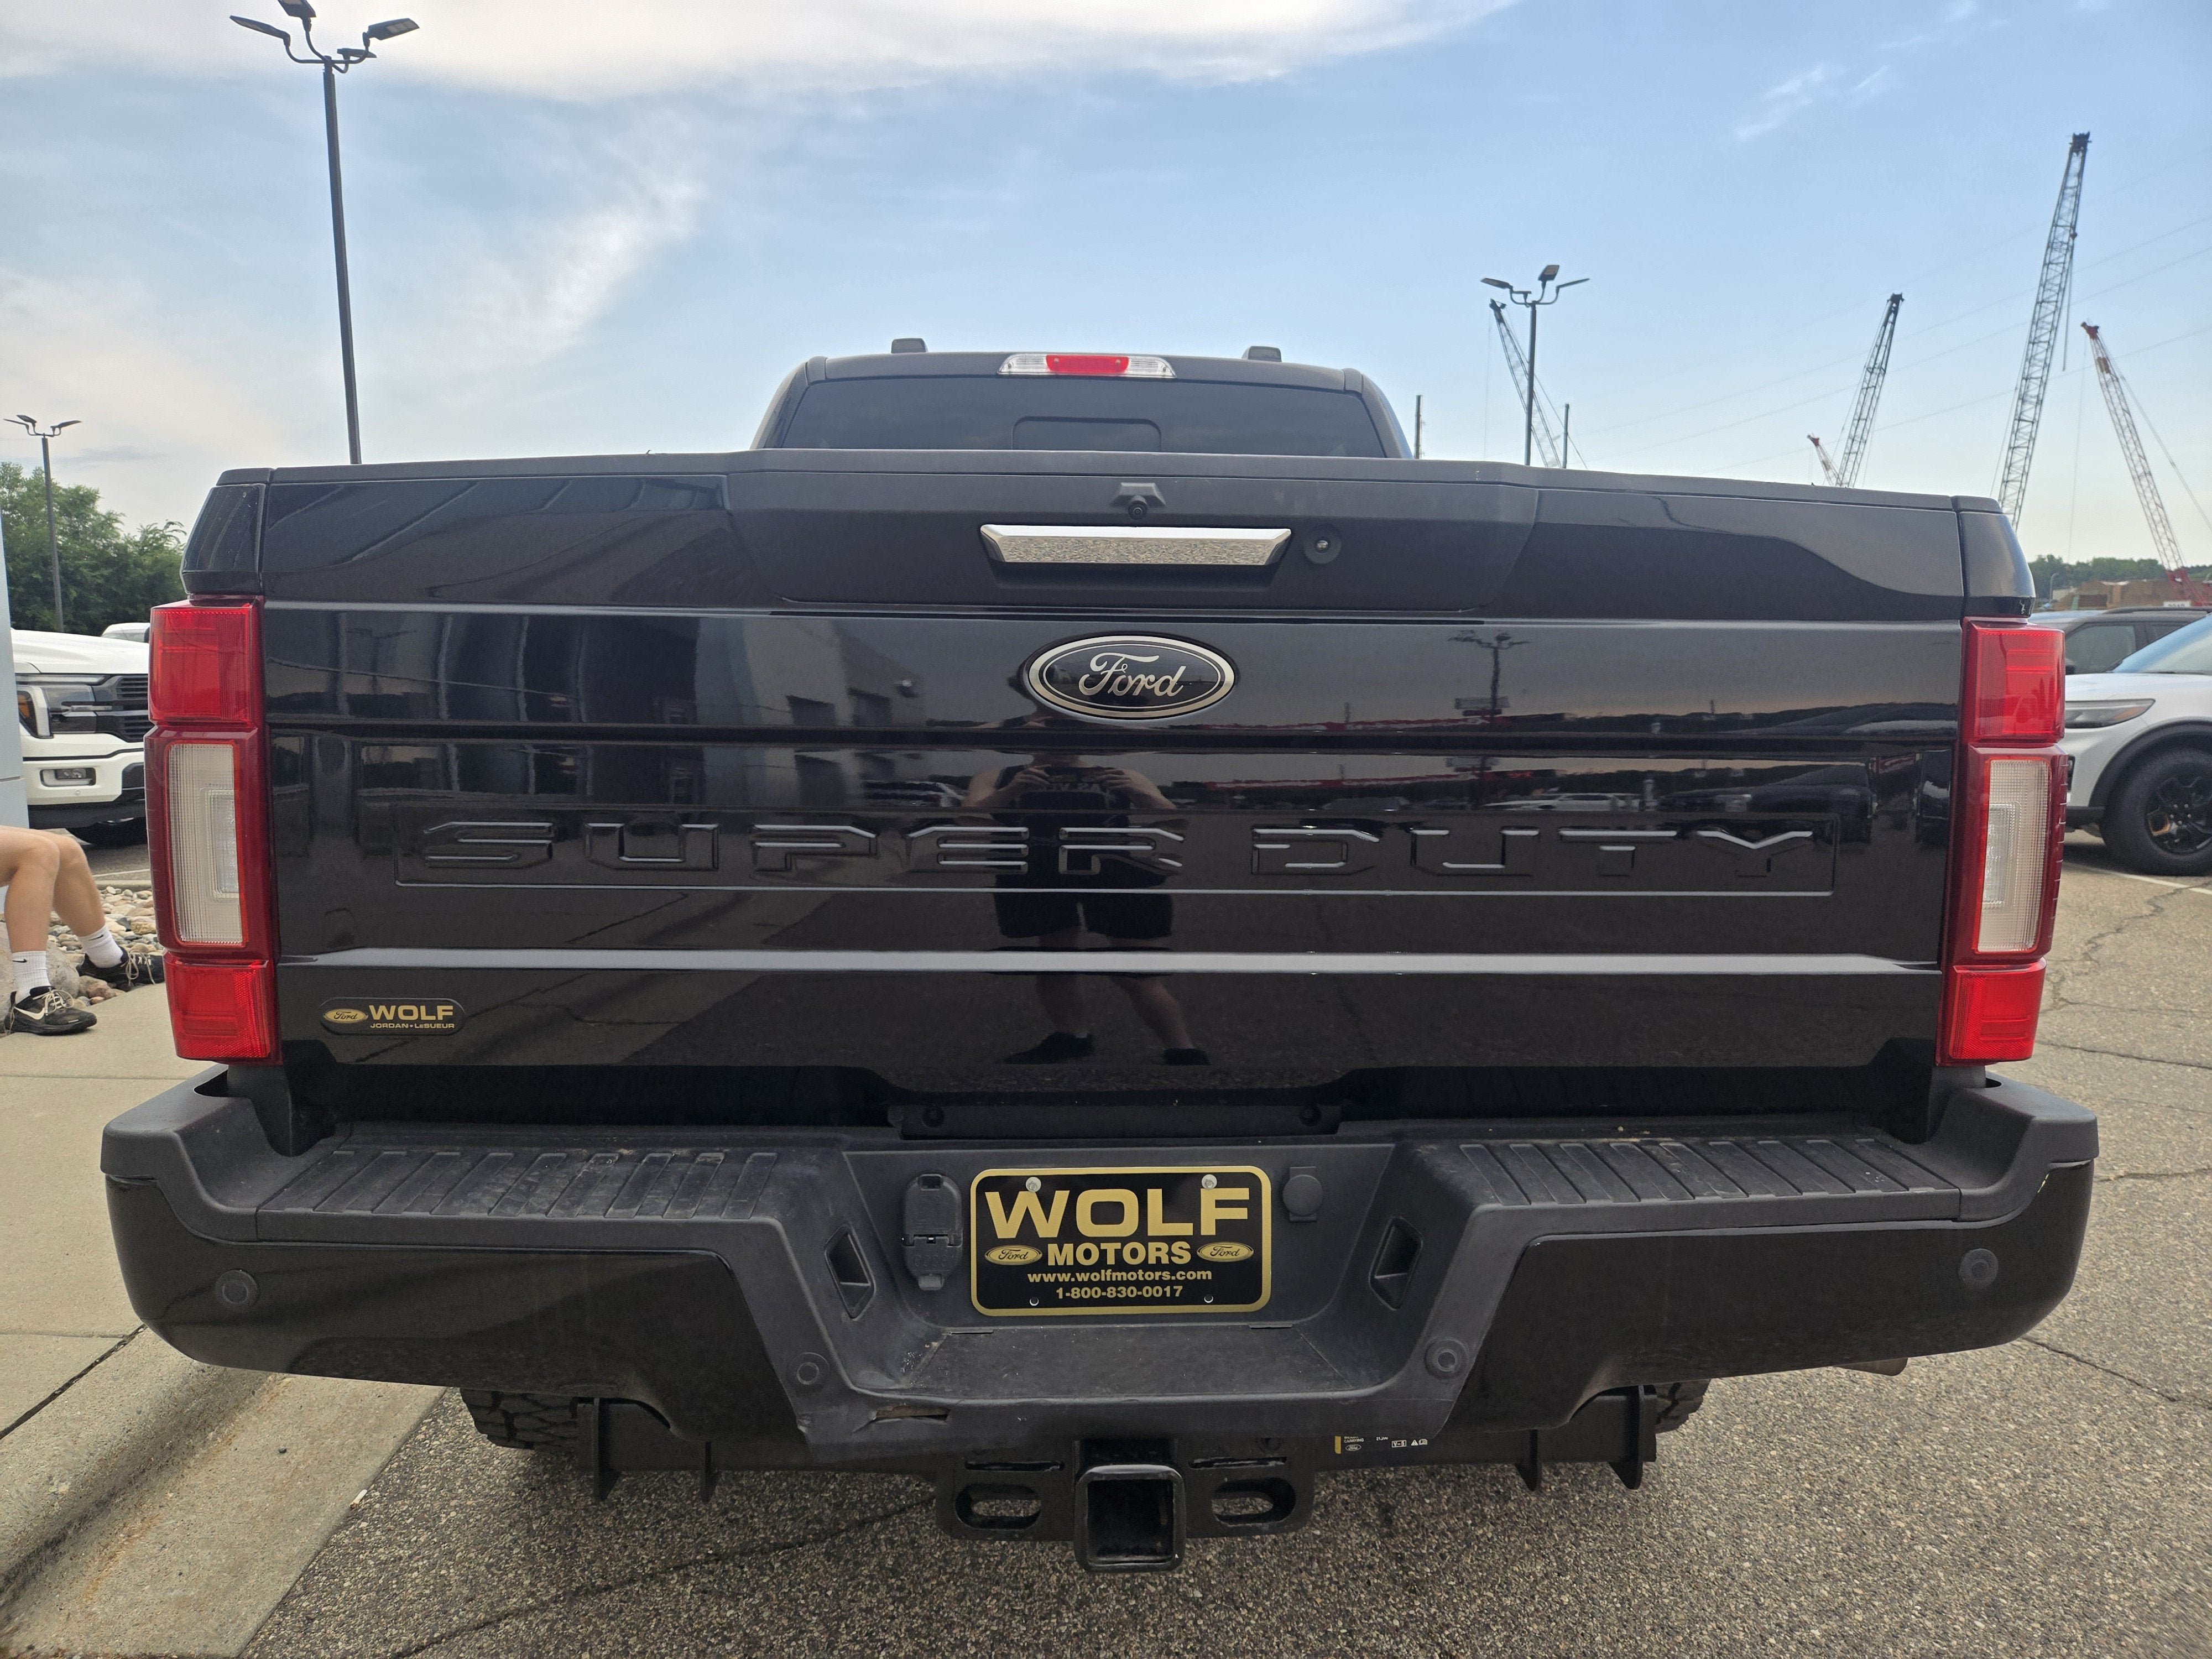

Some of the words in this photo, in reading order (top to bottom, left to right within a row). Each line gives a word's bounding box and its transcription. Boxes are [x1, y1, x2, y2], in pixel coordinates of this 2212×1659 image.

[1078, 652, 1187, 697] Ford
[423, 821, 1187, 876] SUPER
[1251, 827, 1814, 878] DUTY
[333, 1010, 358, 1020] Ford
[368, 1005, 454, 1020] WOLF
[984, 1187, 1250, 1239] WOLF
[998, 1248, 1029, 1261] Ford
[1047, 1241, 1192, 1266] MOTORS
[1208, 1245, 1240, 1258] Ford
[1027, 1269, 1212, 1283] www.wolfmotors.com
[1056, 1285, 1183, 1299] 1-800-830-0017
